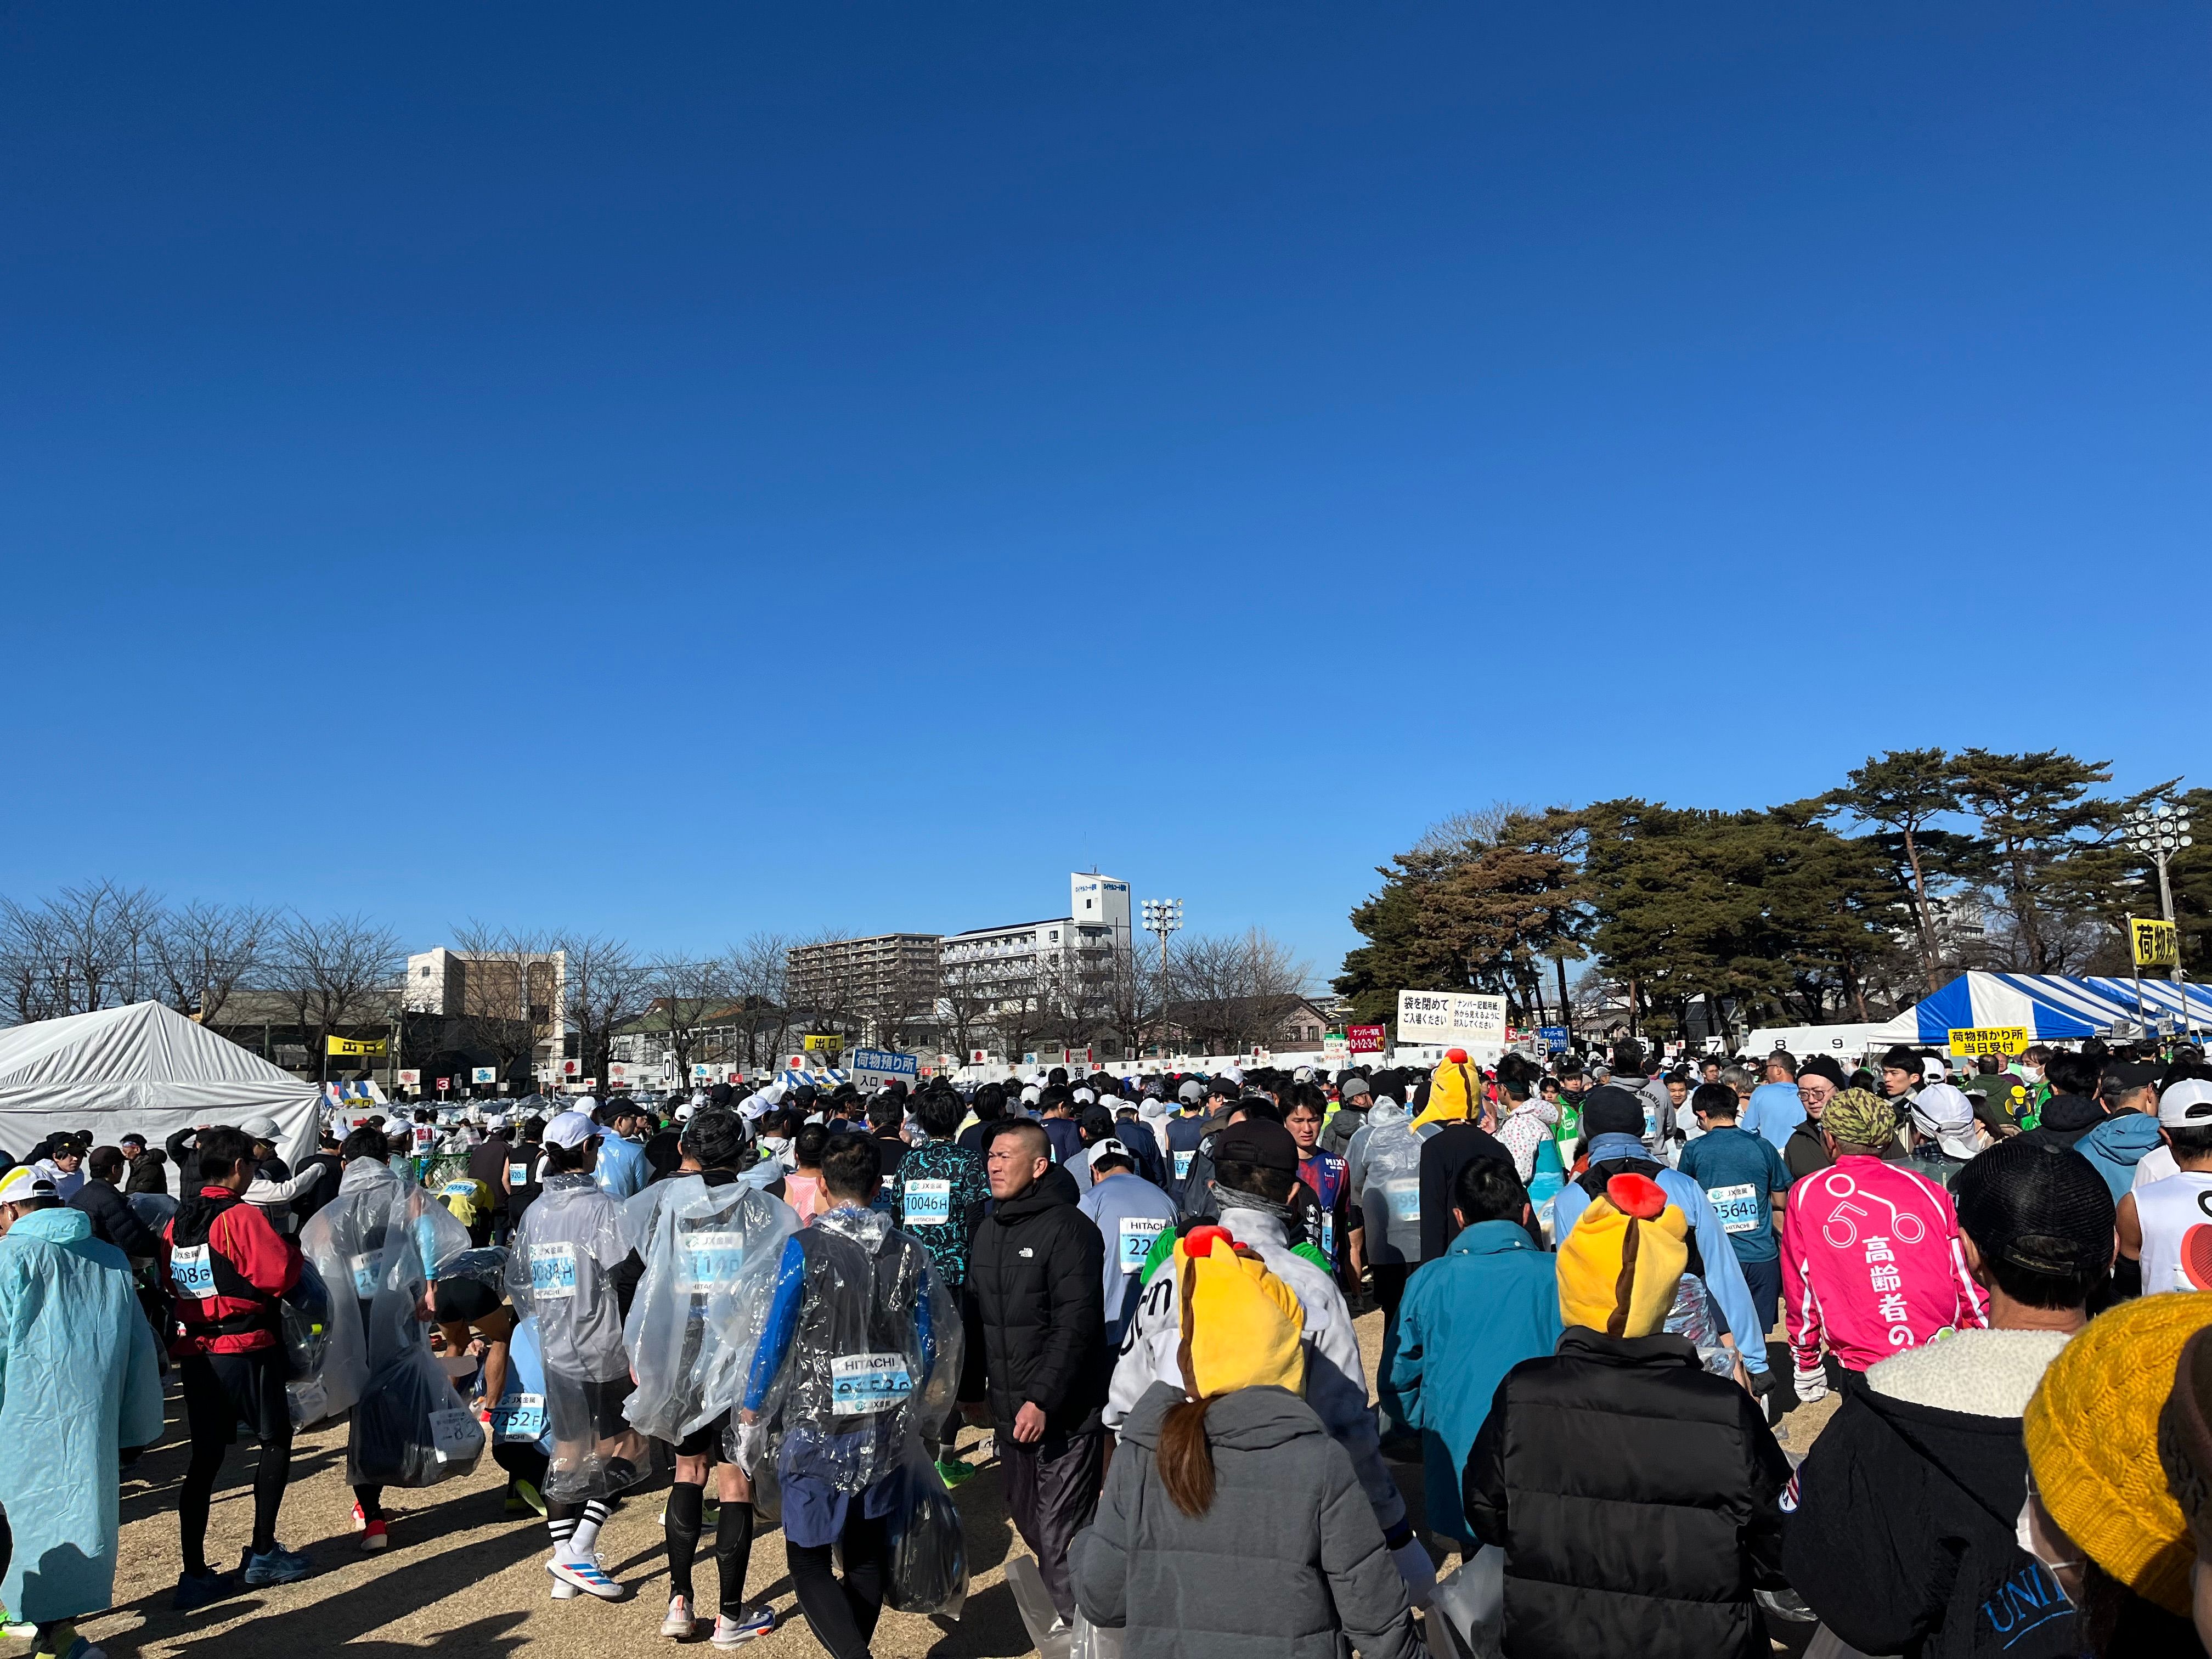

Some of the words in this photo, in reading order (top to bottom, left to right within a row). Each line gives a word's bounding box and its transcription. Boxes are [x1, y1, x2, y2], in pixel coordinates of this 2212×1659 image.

[1404, 996, 1449, 1011] 袋を閉めて
[1403, 1013, 1447, 1025] ご入場ください
[1454, 1009, 1500, 1020] 外から見えるように
[1454, 1019, 1494, 1029] 封入してください
[1952, 1029, 2023, 1042] 荷物預かり所
[342, 1041, 376, 1053] 出口
[815, 1038, 837, 1049] 出口
[1537, 1043, 1546, 1056] 5
[1708, 1041, 1720, 1052] 7
[1775, 1040, 1786, 1050] 8
[1832, 1039, 1843, 1048] 9
[1964, 1041, 2014, 1054] 当日受付
[857, 1052, 914, 1073] 荷物預り所
[1074, 1067, 1085, 1080] 荷
[438, 1080, 449, 1090] 3
[860, 1075, 878, 1087] 入口
[1325, 1158, 1345, 1166] MIXI
[1726, 1188, 1748, 1197] JX金属
[906, 1197, 947, 1211] 10046H
[1131, 1222, 1166, 1231] HITACH
[1129, 1238, 1156, 1256] 22
[1862, 1235, 1915, 1353] 高齢者の
[845, 1357, 895, 1371] HITACHI
